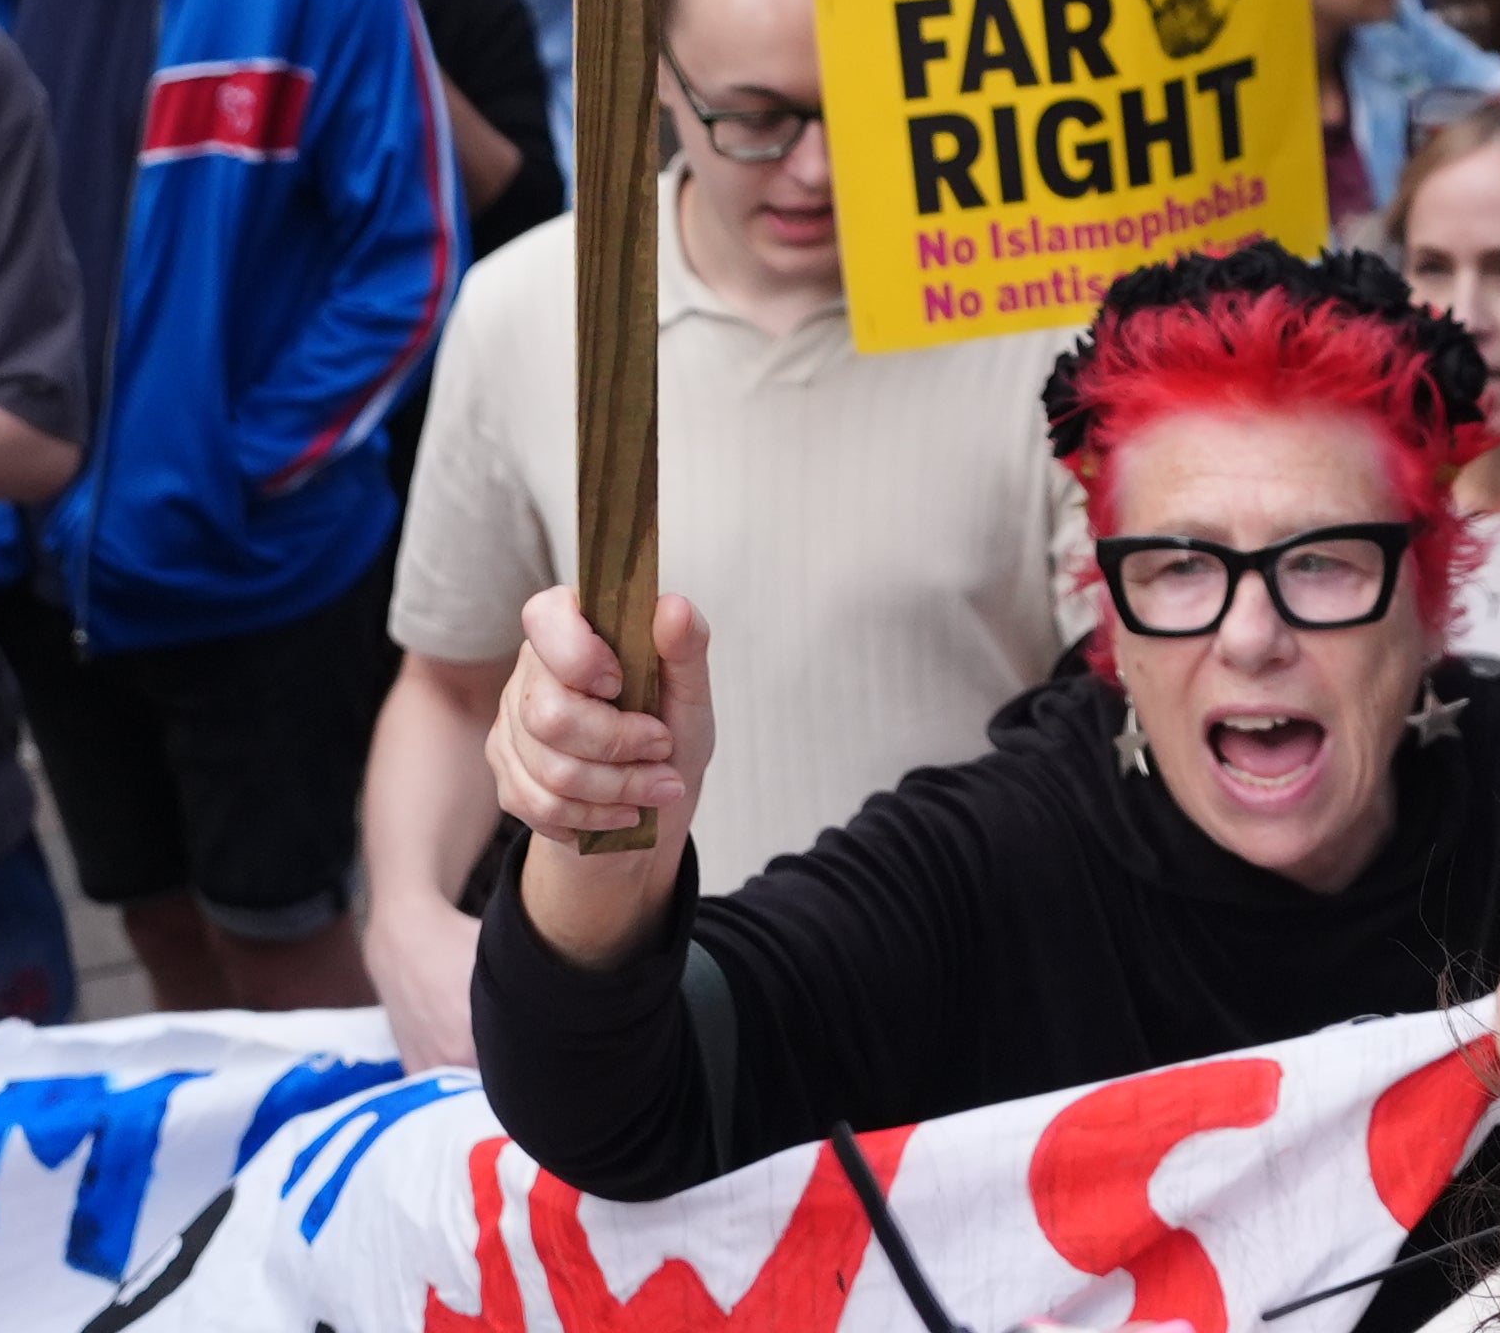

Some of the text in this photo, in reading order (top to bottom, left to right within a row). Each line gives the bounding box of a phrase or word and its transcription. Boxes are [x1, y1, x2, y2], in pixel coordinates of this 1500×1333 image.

[906, 55, 1257, 216] RIGHT
[916, 173, 1268, 271] No Islamophobia
[923, 281, 984, 324] No
